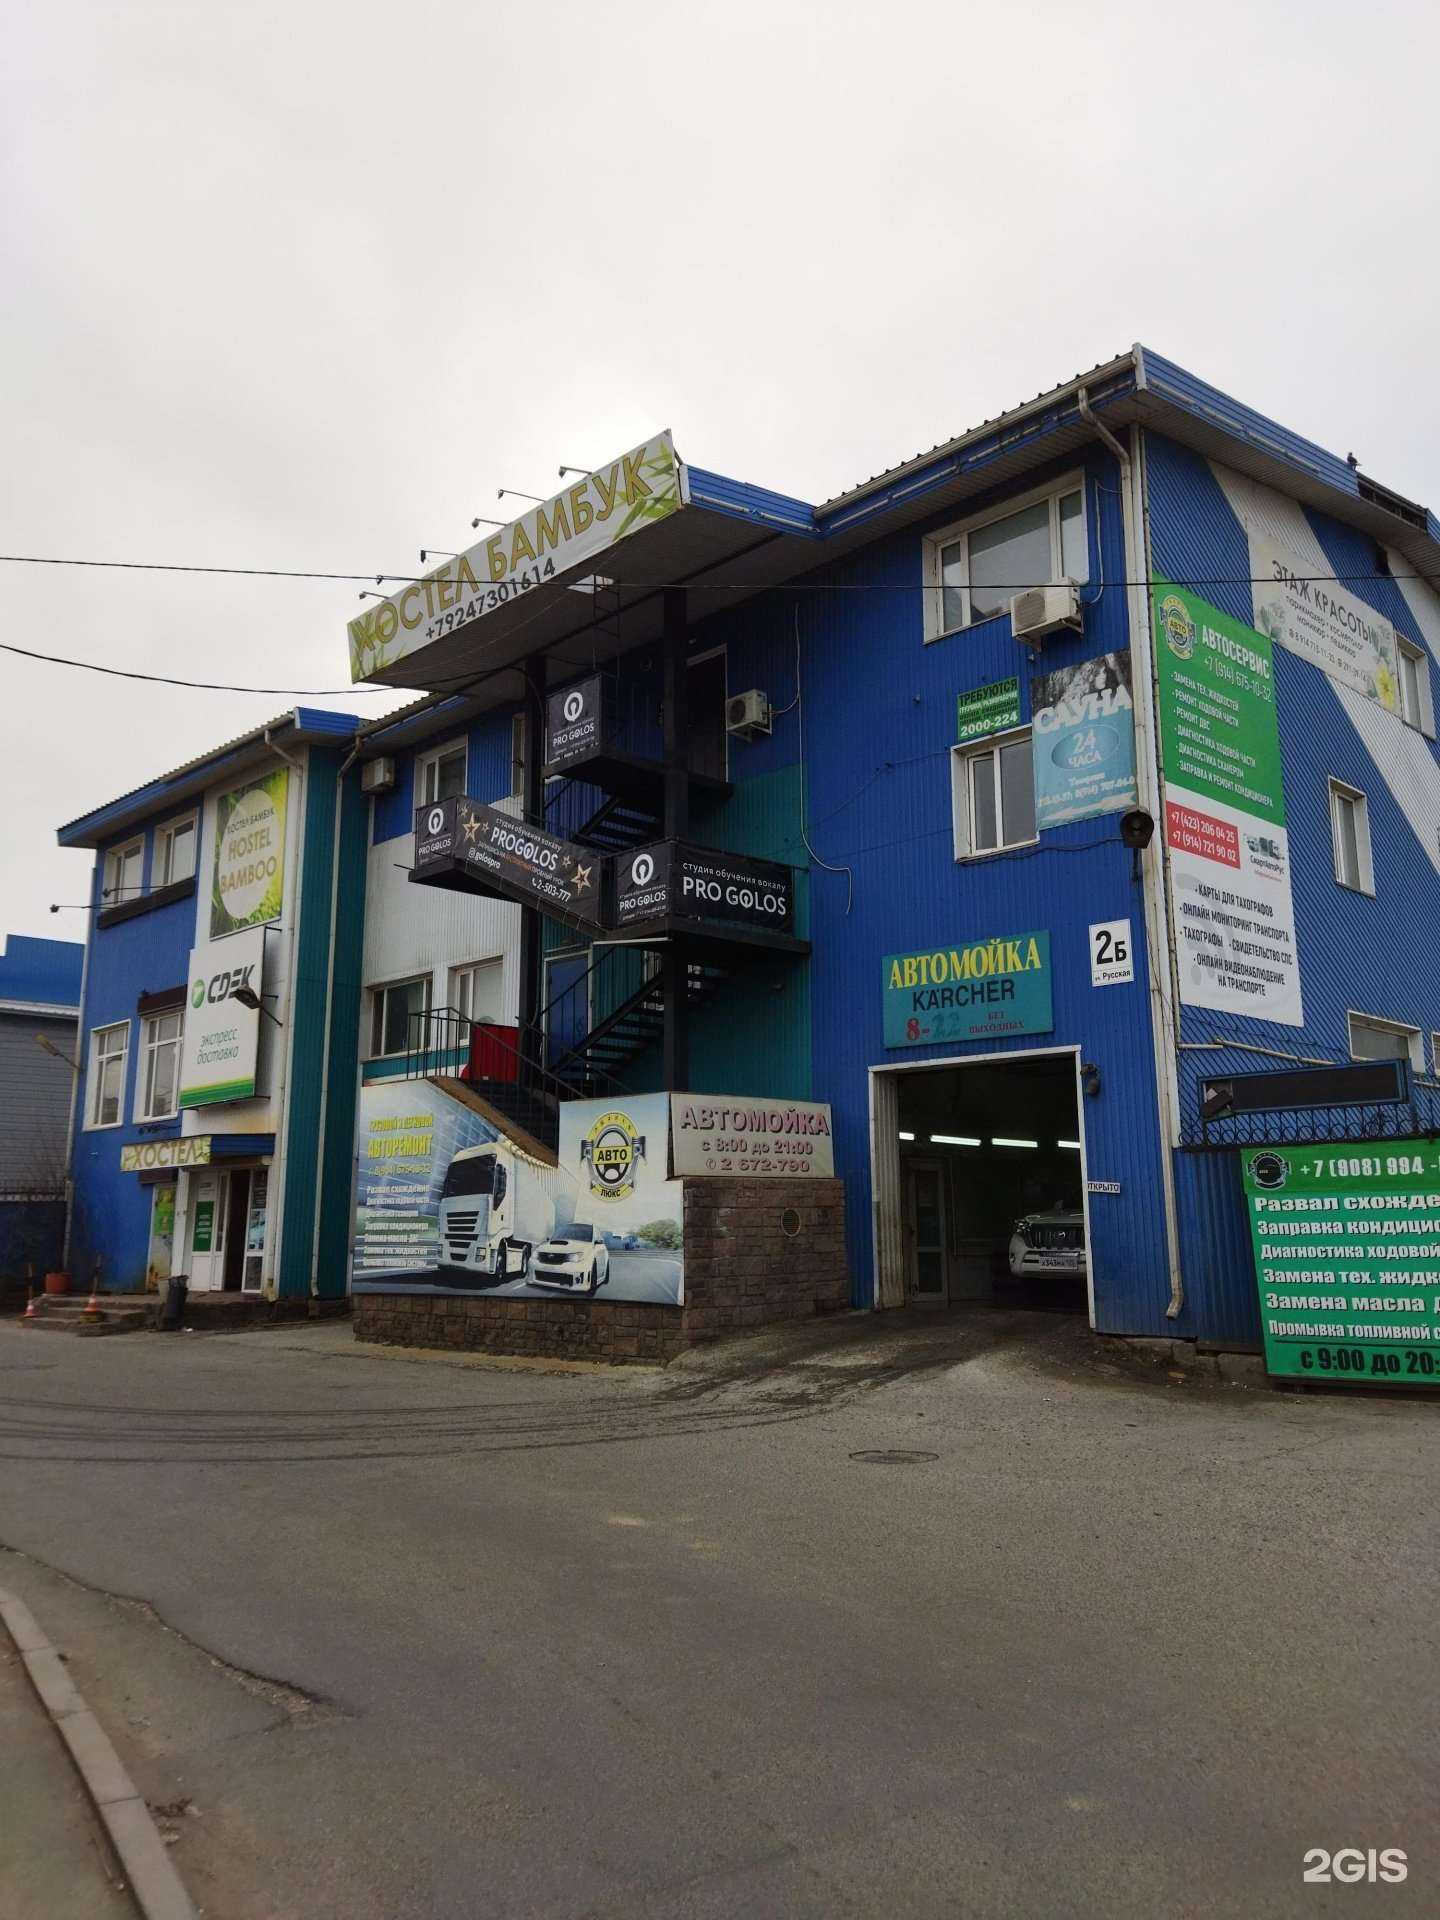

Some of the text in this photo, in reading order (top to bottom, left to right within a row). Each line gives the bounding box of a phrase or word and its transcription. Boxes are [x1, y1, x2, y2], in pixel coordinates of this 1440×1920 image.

[352, 447, 653, 652] ХОСТЕЛ БАМБУК
[426, 558, 555, 640] +79247301614
[1272, 560, 1371, 643] ЭТАЖ КРАСОТЫ
[1202, 624, 1270, 679] АВТОСЕРВИС
[1173, 671, 1196, 692] ЗАМЕНА
[1034, 684, 1133, 735] САУНА
[1175, 688, 1197, 708] РЕМОНТ
[960, 711, 1018, 737] 2000-224
[1176, 706, 1198, 725] РЕМОНТ
[553, 734, 568, 747] PRO
[569, 722, 594, 741] GOLOS
[1073, 728, 1096, 753] 24
[1068, 749, 1102, 769] ЧАСА
[1171, 811, 1235, 844] +7 (423) 206 04 25
[228, 827, 271, 861] HOSTEL
[491, 827, 558, 871] PROGOLOS
[1173, 830, 1236, 862] +7 (914) 721 90 02
[221, 856, 277, 895] BAMBOO
[682, 862, 786, 893] студия обучения вокалу
[537, 879, 572, 903] 2-503-777
[620, 898, 636, 911] PRO
[637, 890, 666, 906] GOLOS
[683, 876, 722, 901] PRO
[726, 886, 786, 915] GOLOS
[1198, 884, 1274, 918] КАРТЫ ДЛЯ ТАХОГРАФОВ
[1183, 902, 1290, 943] ОНЛАЙН МОНИТОРИНГ ТРАНСПОРТА
[1095, 930, 1127, 965] 2Б
[1183, 926, 1223, 947] ТАХОГРАФЫ
[1231, 938, 1280, 963] СВИДЕТЕЛЬСТВО
[888, 936, 1042, 990] АВТОМОЙКА
[1102, 969, 1131, 981] Русская
[1196, 952, 1286, 985] ОНЛАЙН ВИДЕОНАБЛЮДЕНИЕ
[207, 964, 255, 1003] CDEK
[1218, 974, 1266, 996] НА ТРАНСПОРТЕ
[200, 1028, 238, 1048] экспресс
[197, 1046, 239, 1064] доставка
[681, 1104, 831, 1137] АВТОМОЙКА
[133, 1139, 198, 1168] ХОСТЕЛ
[597, 1149, 628, 1162] АВТО
[702, 1140, 711, 1152] с
[752, 1143, 769, 1156] до
[773, 1138, 814, 1155] 21:00
[721, 1157, 811, 1172] 2 672-790
[1387, 1155, 1424, 1175] 994
[600, 1189, 621, 1198] ЛЮКС
[1254, 1196, 1339, 1212] Развал
[1258, 1220, 1344, 1236] Заправка
[1261, 1242, 1440, 1259] Диагностика ходовой
[1263, 1269, 1335, 1284] Замена
[1339, 1270, 1376, 1284] тех.
[1266, 1293, 1347, 1310] Замена
[1352, 1297, 1426, 1312] масла
[1268, 1319, 1345, 1337] Промывка
[1346, 1323, 1431, 1340] топливной
[1301, 1351, 1313, 1369] с
[1317, 1348, 1365, 1372] 9:00
[1371, 1354, 1400, 1376] до
